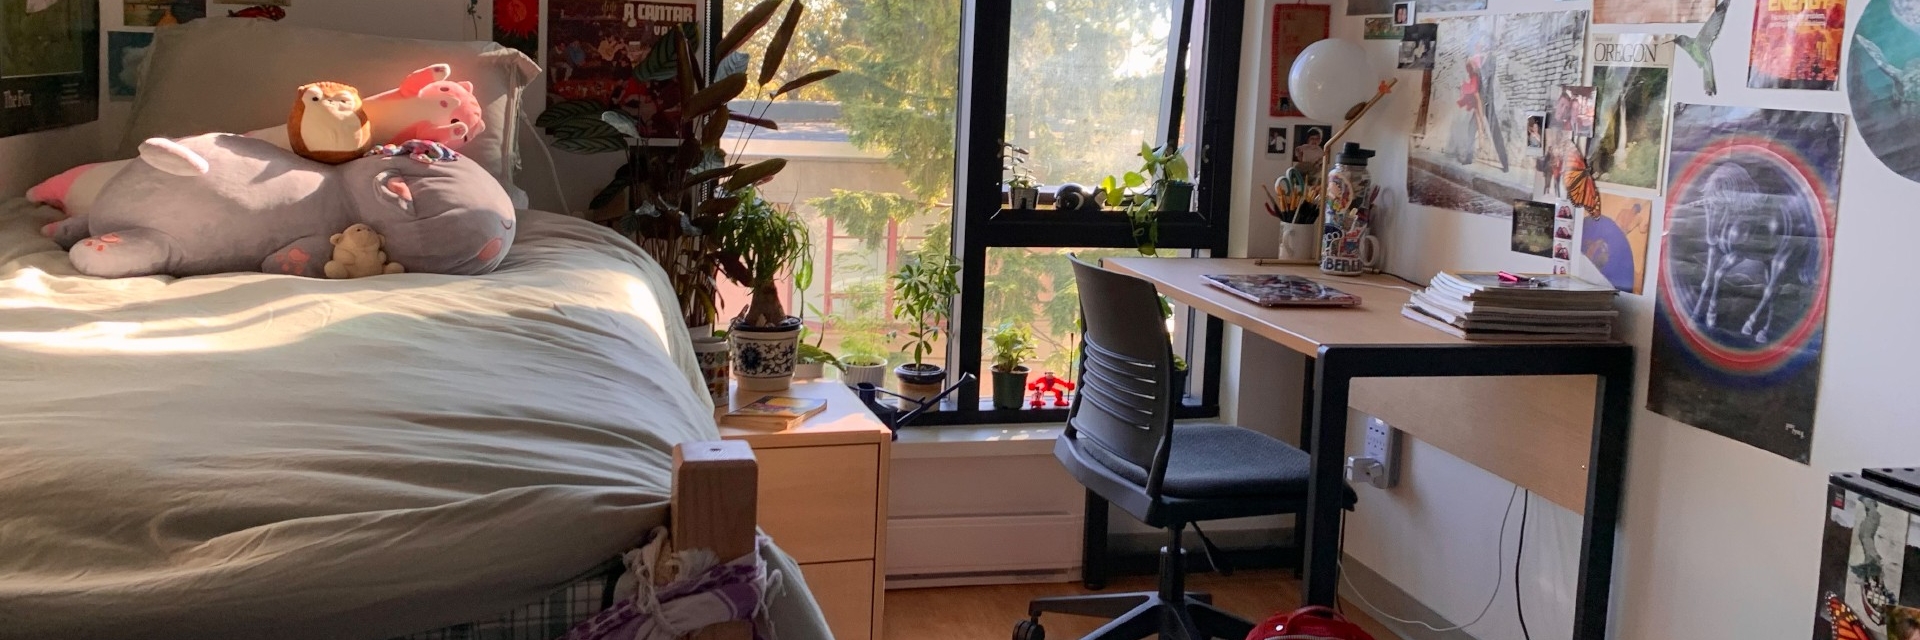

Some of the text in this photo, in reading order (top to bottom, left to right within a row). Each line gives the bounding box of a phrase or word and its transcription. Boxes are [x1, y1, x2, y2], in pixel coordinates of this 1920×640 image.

[623, 3, 693, 22] A CANTAR
[1594, 42, 1659, 63] OREGON
[3, 89, 17, 109] The
